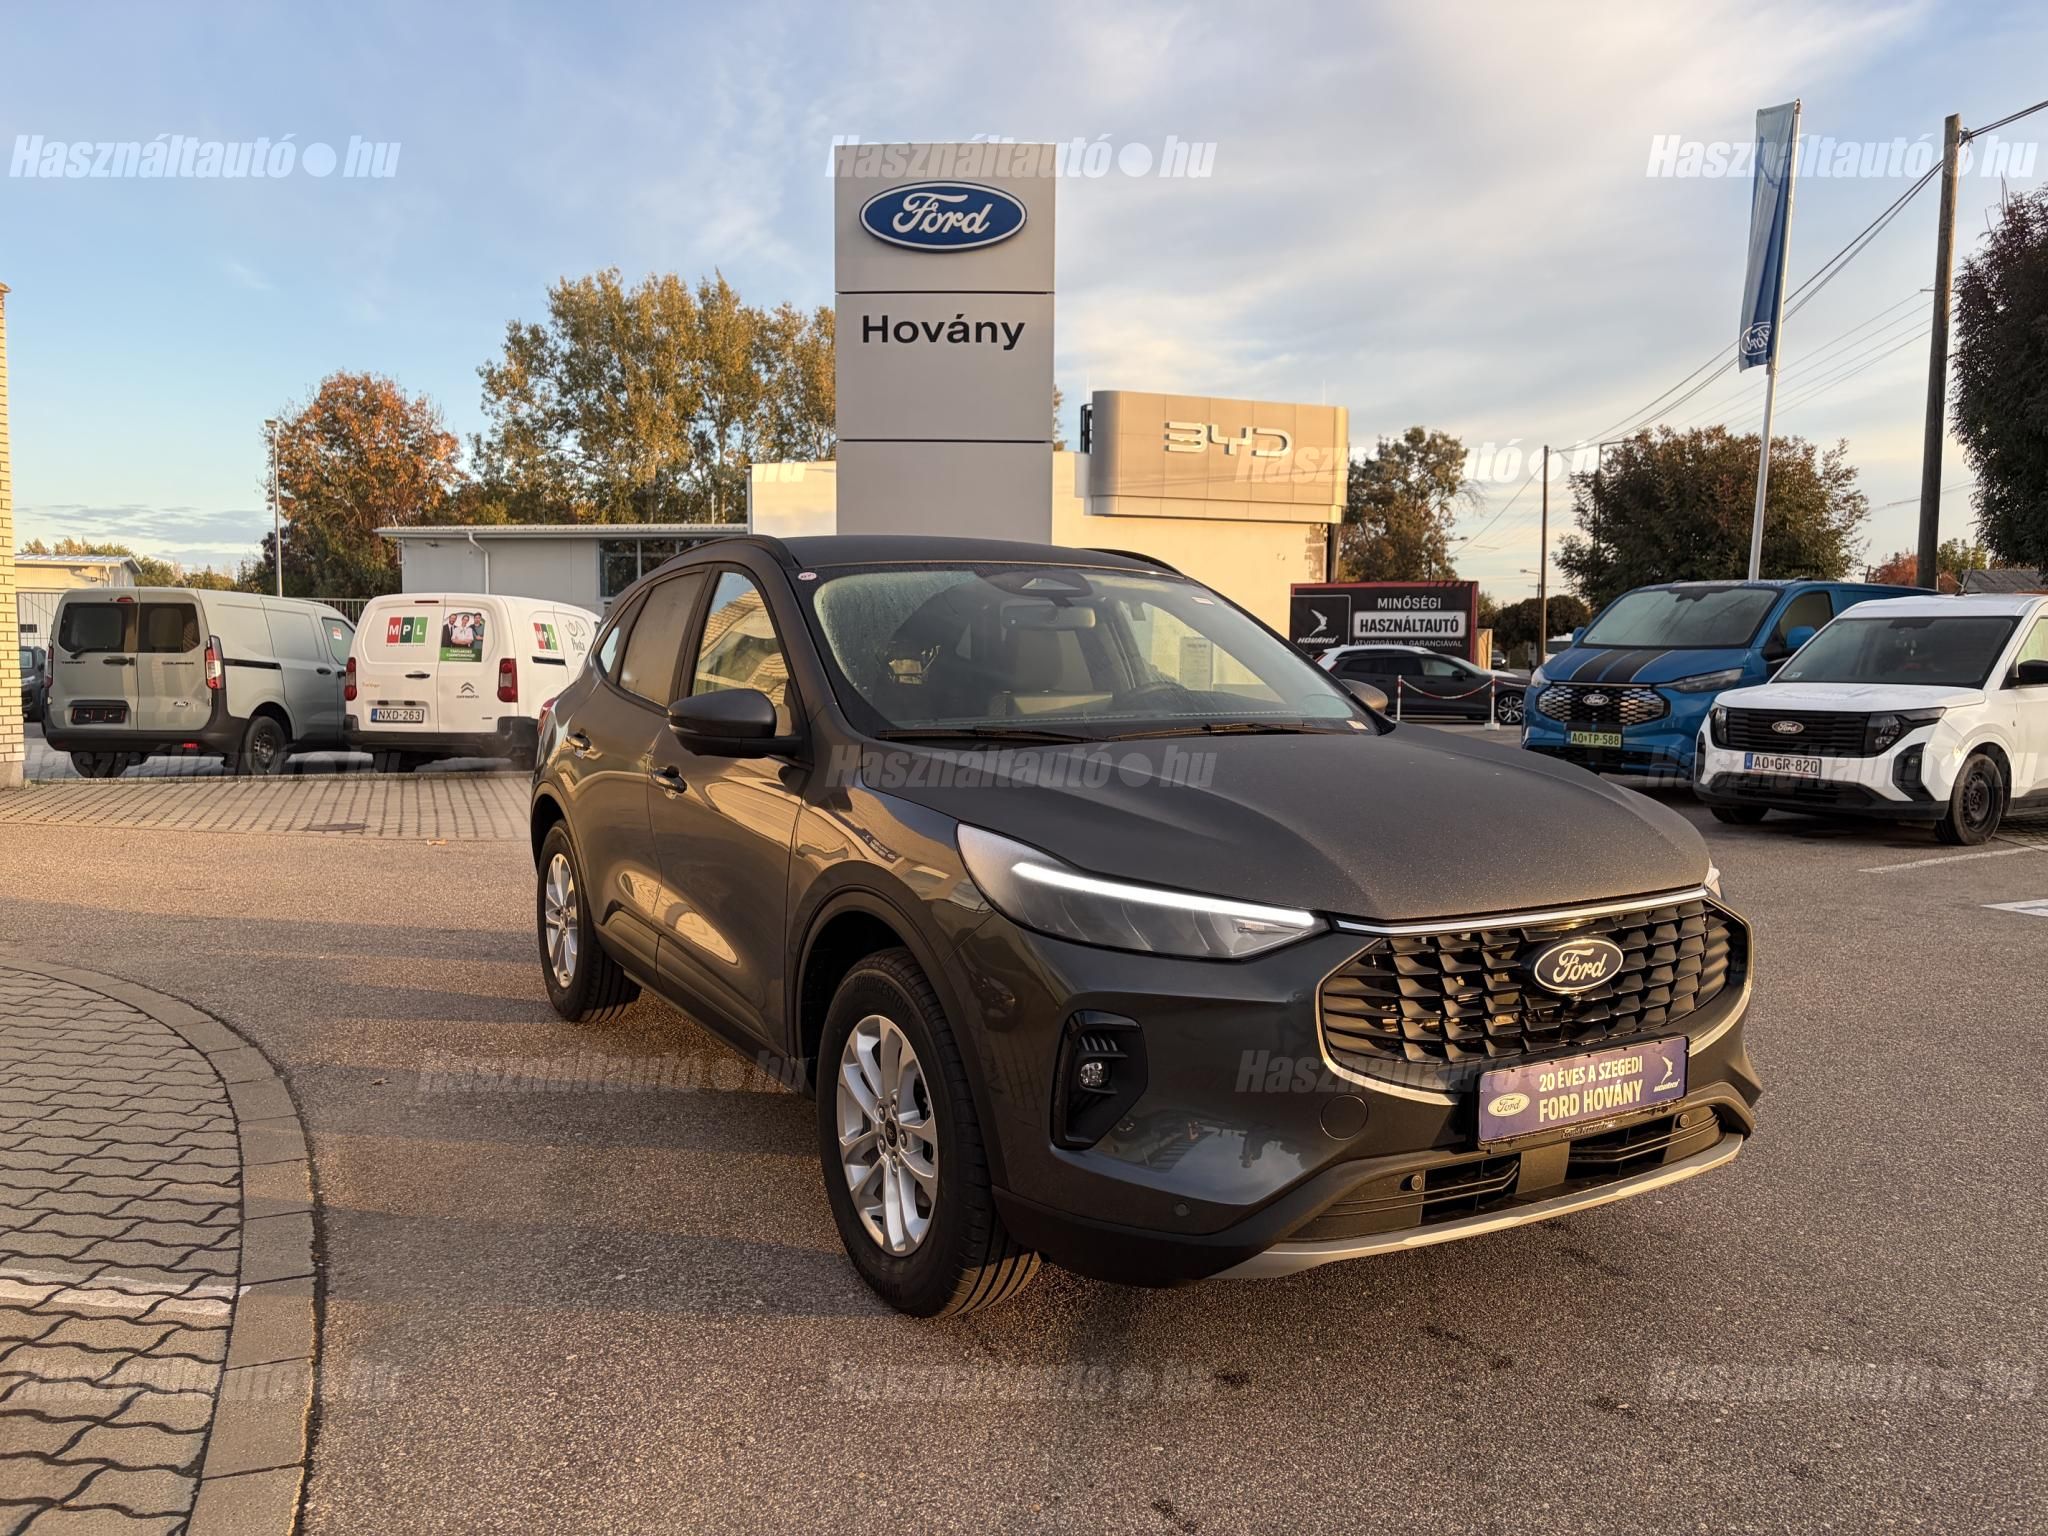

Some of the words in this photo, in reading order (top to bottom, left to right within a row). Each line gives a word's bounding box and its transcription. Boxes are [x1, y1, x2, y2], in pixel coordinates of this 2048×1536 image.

[892, 192, 994, 234] Ford
[862, 313, 1026, 351] Hovány
[1165, 421, 1293, 458] BYD
[1377, 595, 1441, 609] MINŐSÉGI
[389, 624, 424, 636] MPL
[1360, 615, 1459, 633] HASZNÁLTAUTÓ
[378, 710, 421, 721] NXD-263
[1553, 947, 1608, 983] Ford
[1539, 1074, 1555, 1093] 20
[1557, 1066, 1586, 1086] ÉVES
[1587, 1063, 1596, 1082] A
[1598, 1055, 1643, 1081] SZEGEDI
[1496, 1096, 1522, 1112] Ford
[1539, 1092, 1580, 1123] FORD
[1583, 1078, 1644, 1114] HOVÁNY
